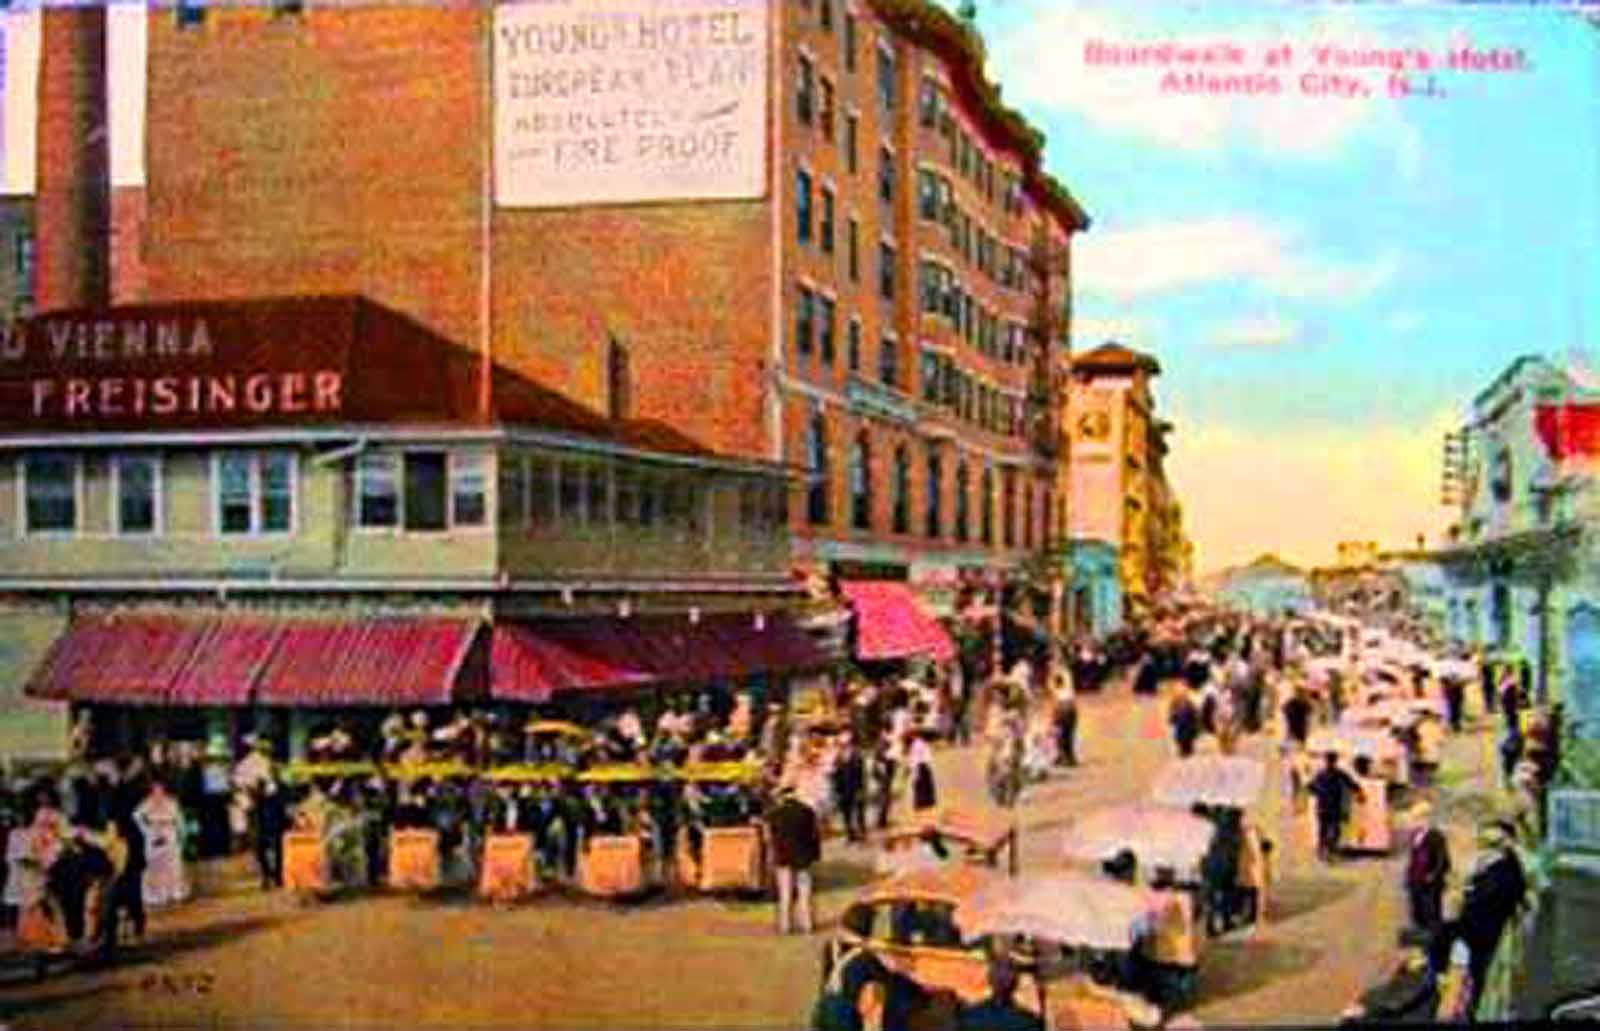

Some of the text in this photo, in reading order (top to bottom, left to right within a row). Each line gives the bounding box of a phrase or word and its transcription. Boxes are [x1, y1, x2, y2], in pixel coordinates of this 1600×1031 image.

[638, 11, 756, 49] HOTEL
[637, 131, 741, 160] PROOF
[50, 320, 213, 359] VIENNA
[31, 369, 343, 417] FREISINGER
